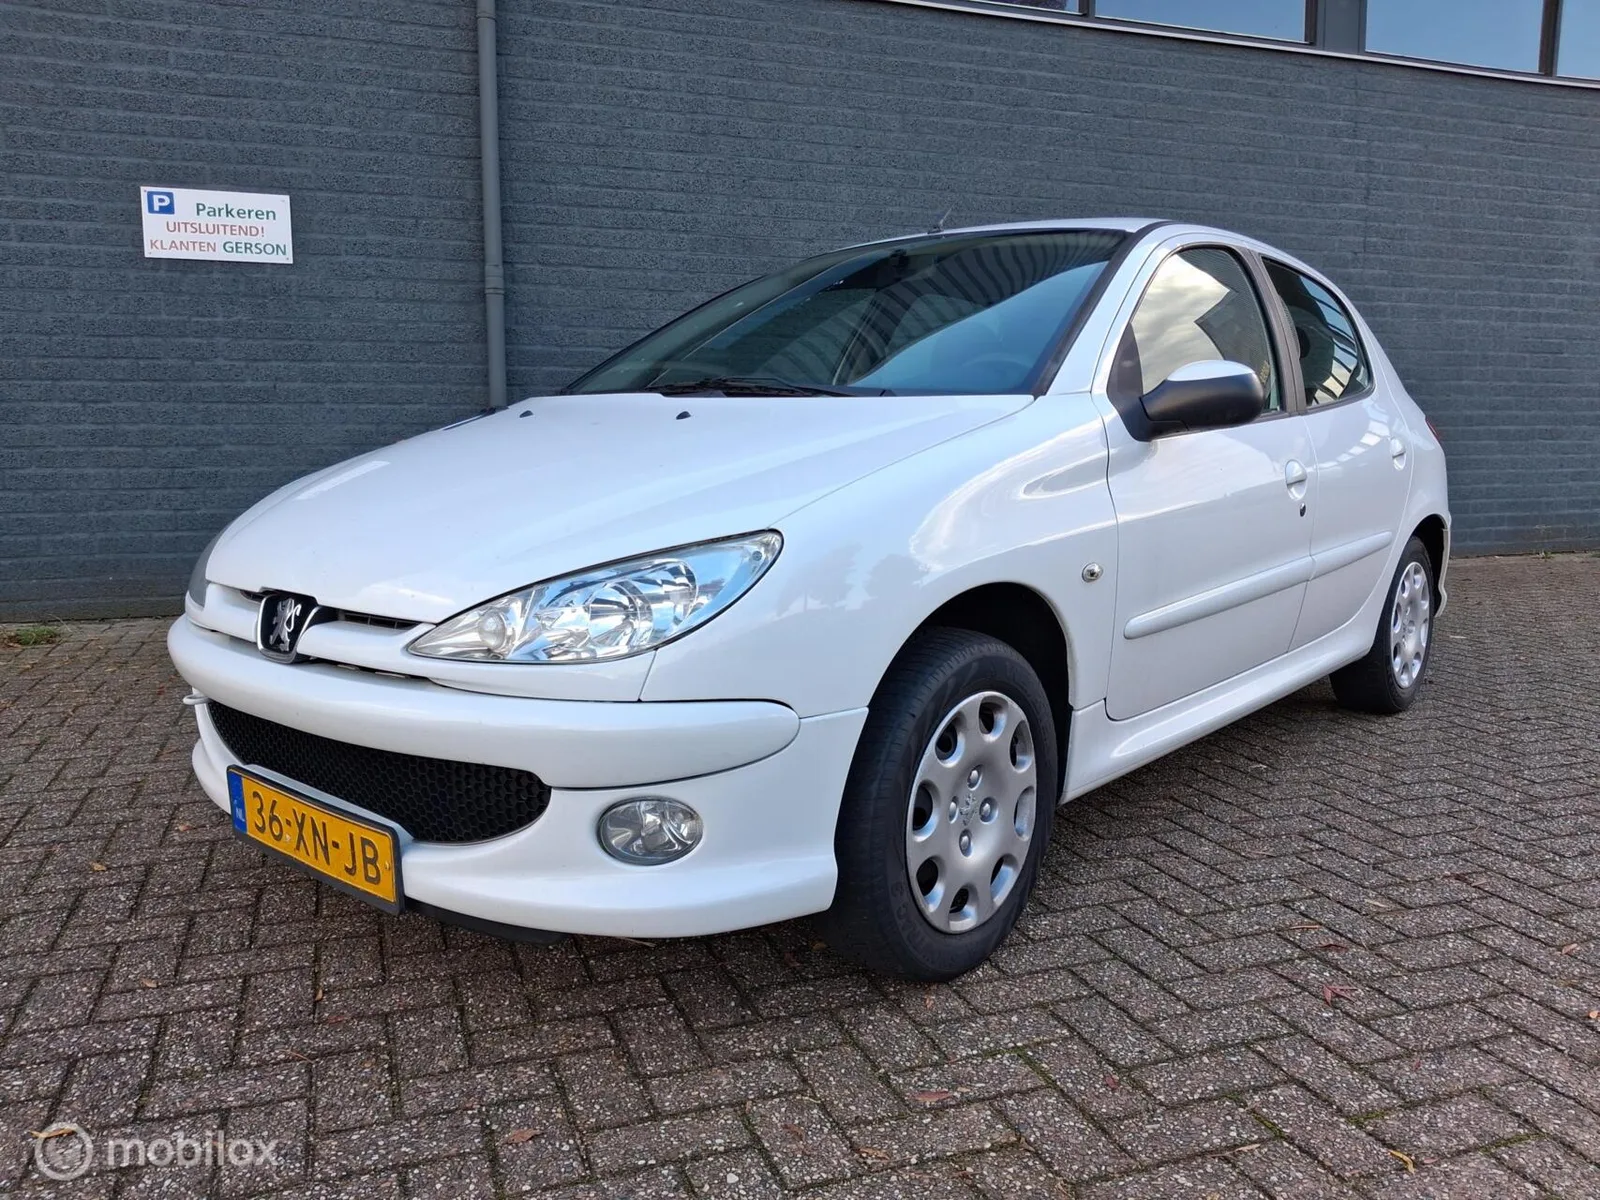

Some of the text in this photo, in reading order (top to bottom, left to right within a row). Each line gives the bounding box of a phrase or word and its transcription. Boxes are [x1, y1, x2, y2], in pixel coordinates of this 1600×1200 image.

[153, 194, 170, 212] P
[196, 202, 276, 221] Parkeren
[166, 220, 265, 238] UITSLUITEND!
[150, 239, 287, 256] KLANTEN GERSON
[252, 790, 382, 885] 36-XN-JB
